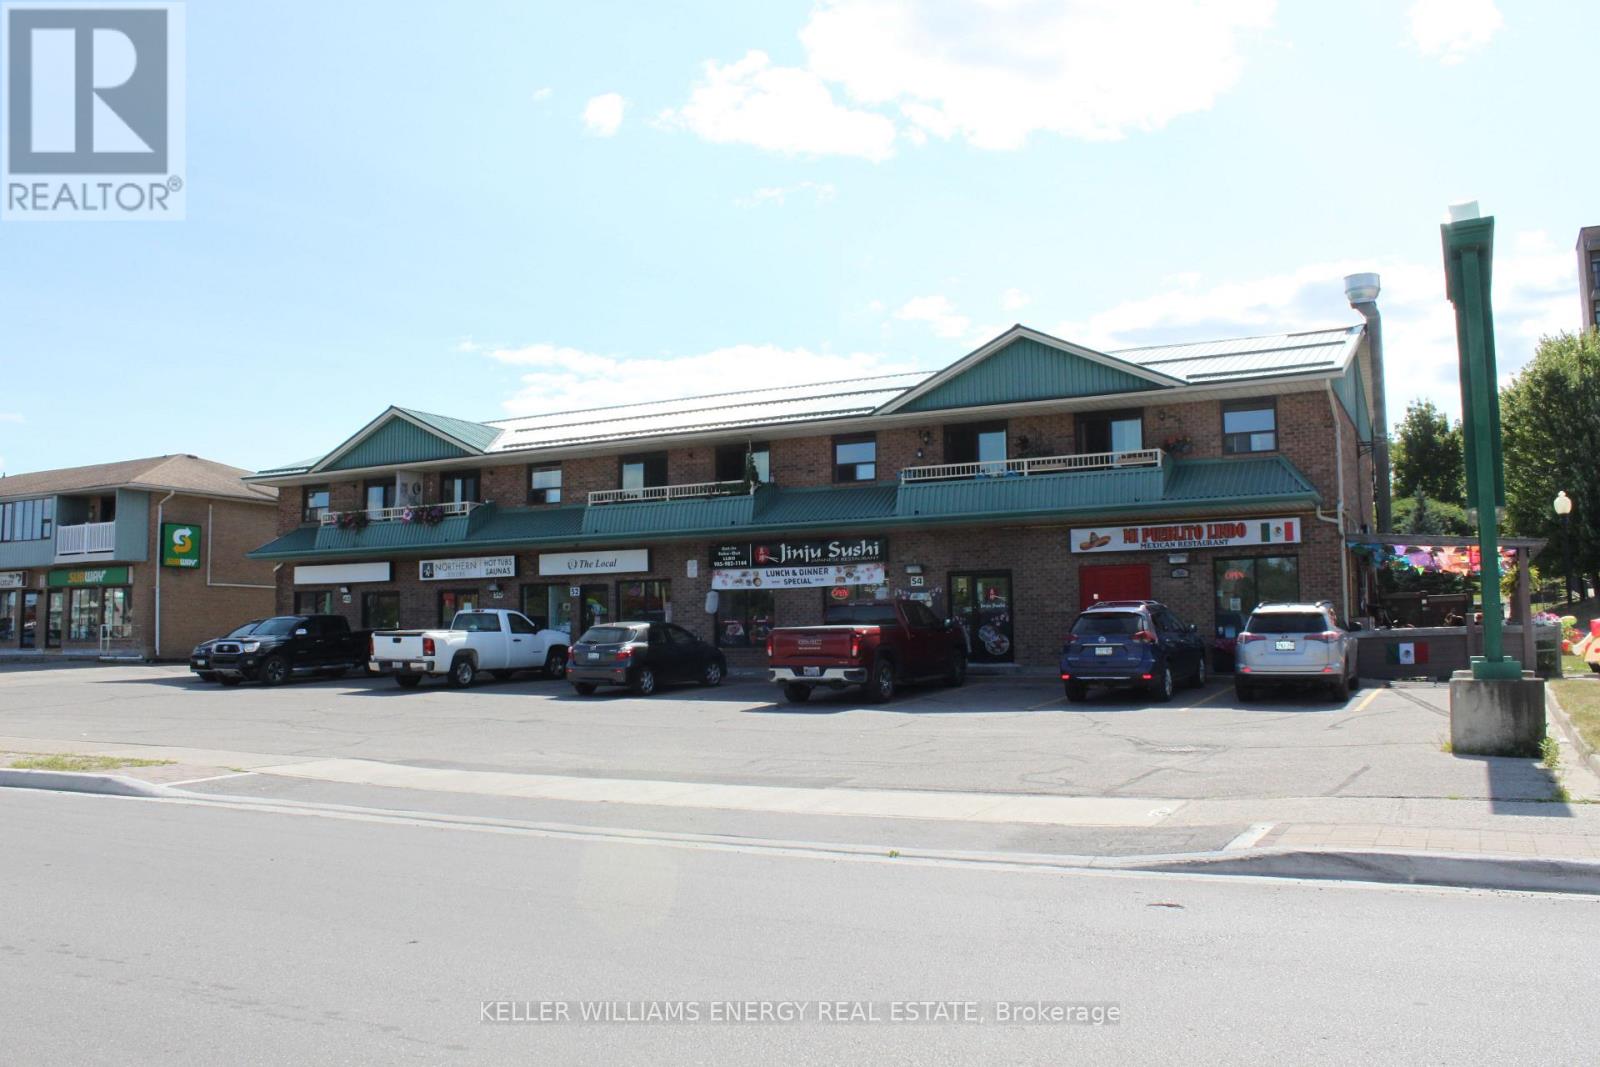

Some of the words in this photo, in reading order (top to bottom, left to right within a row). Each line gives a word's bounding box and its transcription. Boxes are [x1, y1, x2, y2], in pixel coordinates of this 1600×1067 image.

[1207, 522, 1247, 539] LINDO
[1140, 541, 1175, 549] MEXICAN
[1178, 538, 1229, 547] RESTAURANT
[779, 543, 822, 564] Jinju
[828, 540, 880, 558] Sushi
[435, 561, 477, 572] NORTHERN
[498, 558, 512, 566] TUBS
[580, 559, 594, 569] The
[596, 558, 617, 568] Local
[68, 570, 107, 583] SUBWAY
[486, 567, 511, 575] SAUNAS
[765, 569, 790, 577] LUNCH
[799, 567, 829, 576] DINNER
[571, 587, 579, 595] 52
